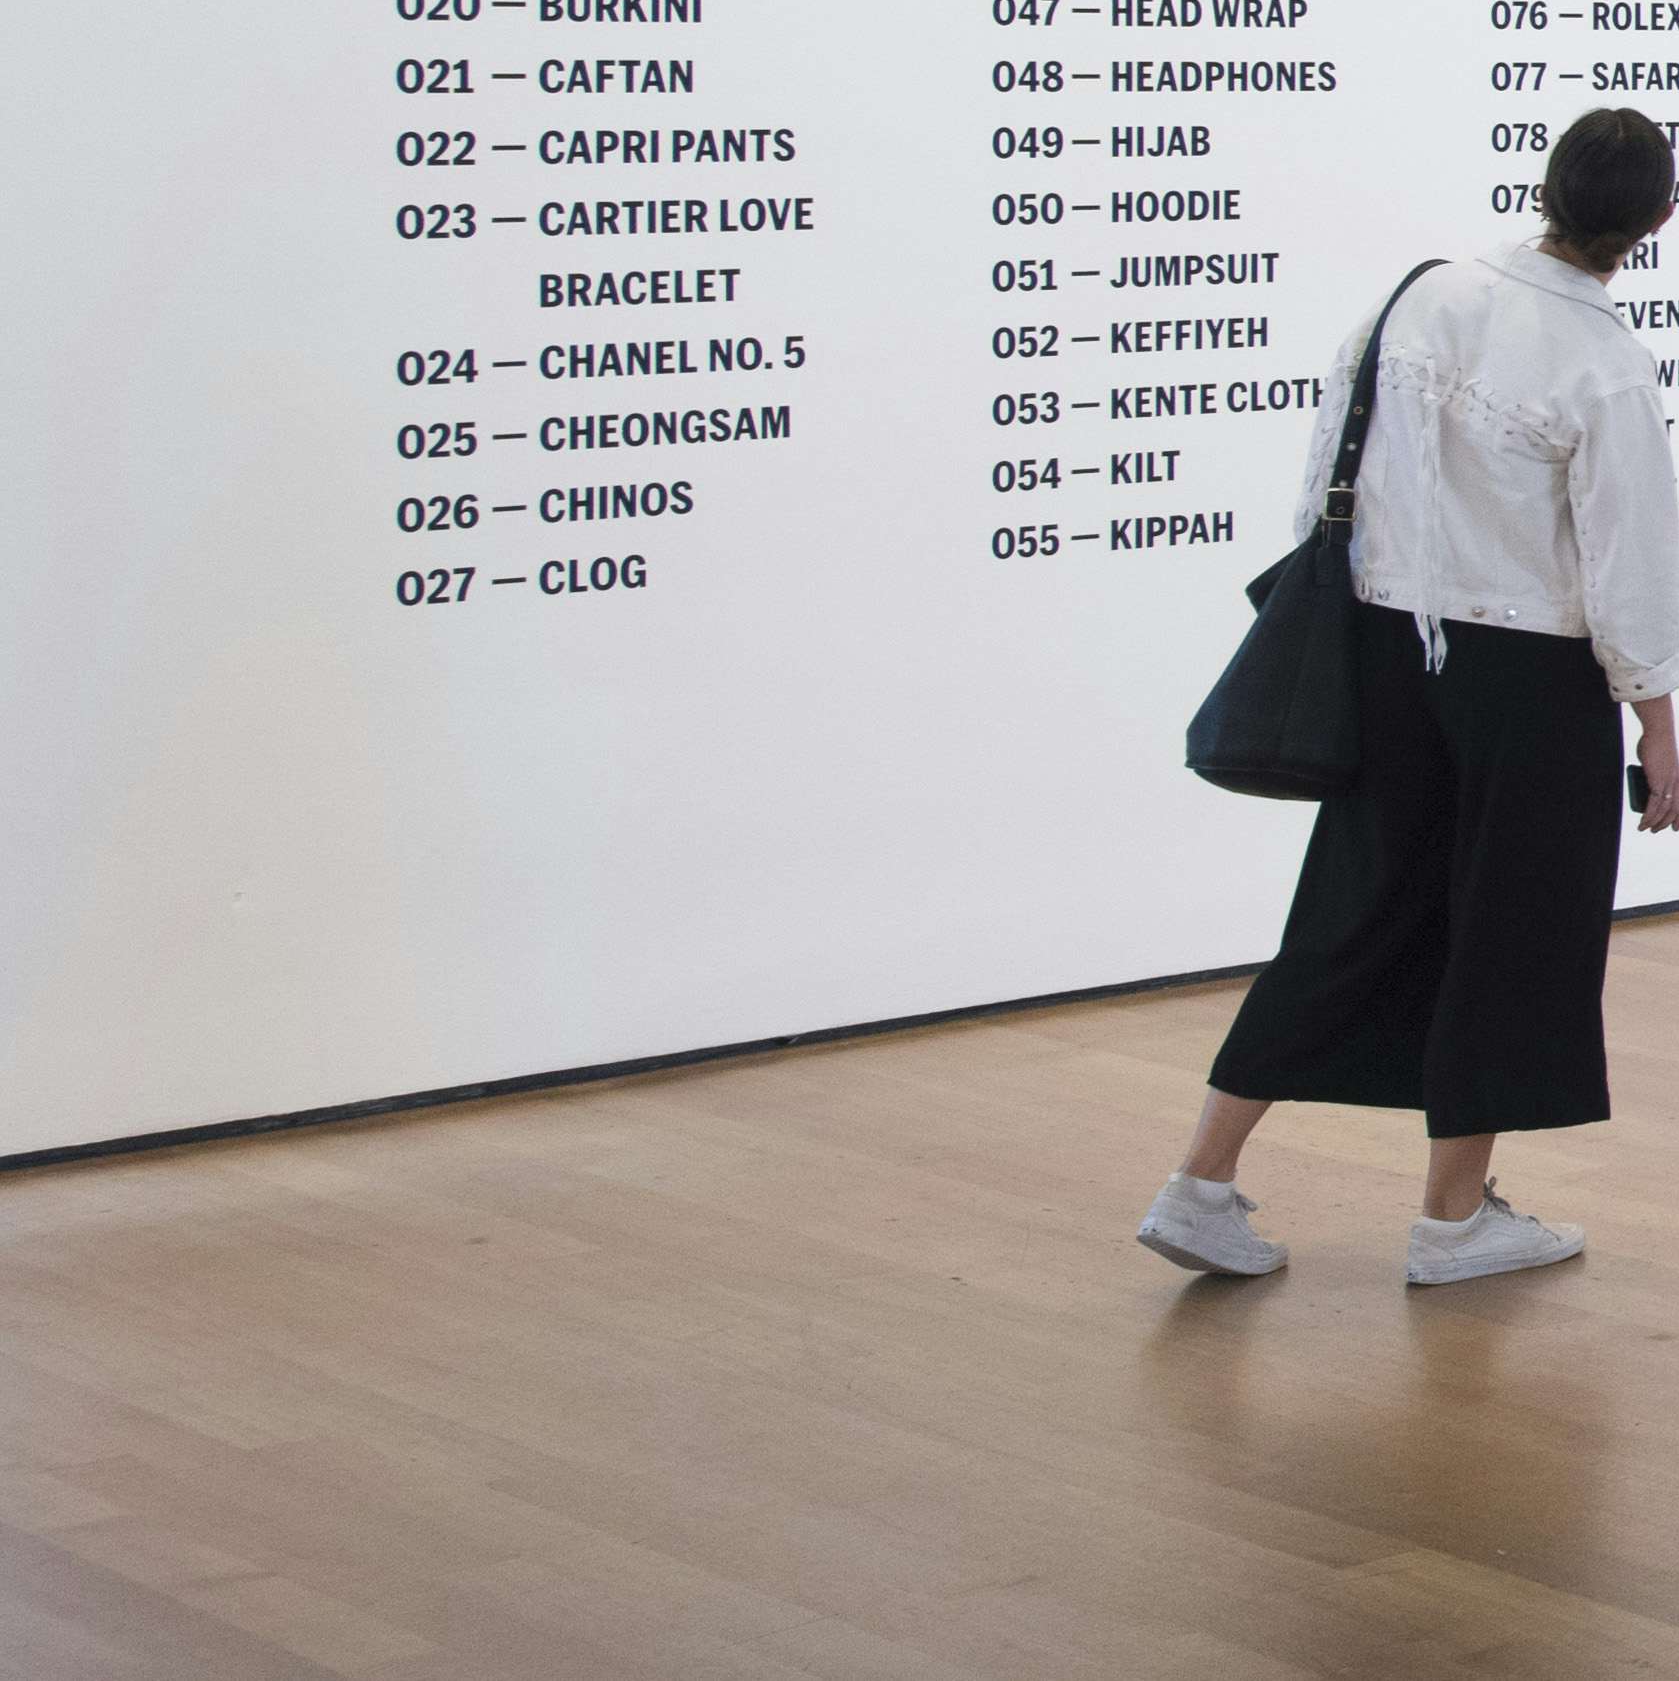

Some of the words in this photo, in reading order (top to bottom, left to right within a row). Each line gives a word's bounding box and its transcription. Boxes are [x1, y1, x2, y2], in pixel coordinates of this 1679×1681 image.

[1491, 1, 1547, 30] 076
[993, 61, 1063, 92] 048
[1112, 61, 1336, 92] HEADPHONES
[1492, 62, 1546, 91] 077
[993, 325, 1058, 359] 052
[1112, 317, 1267, 353] KEFFIYEH
[397, 349, 478, 386] 024
[540, 341, 697, 379] CHANEL
[710, 338, 772, 372] NO.
[784, 336, 805, 368] 5
[992, 524, 1059, 559] 055
[1111, 511, 1233, 550] KIPPAH
[397, 567, 475, 606] 027
[539, 555, 646, 595] CLOG
